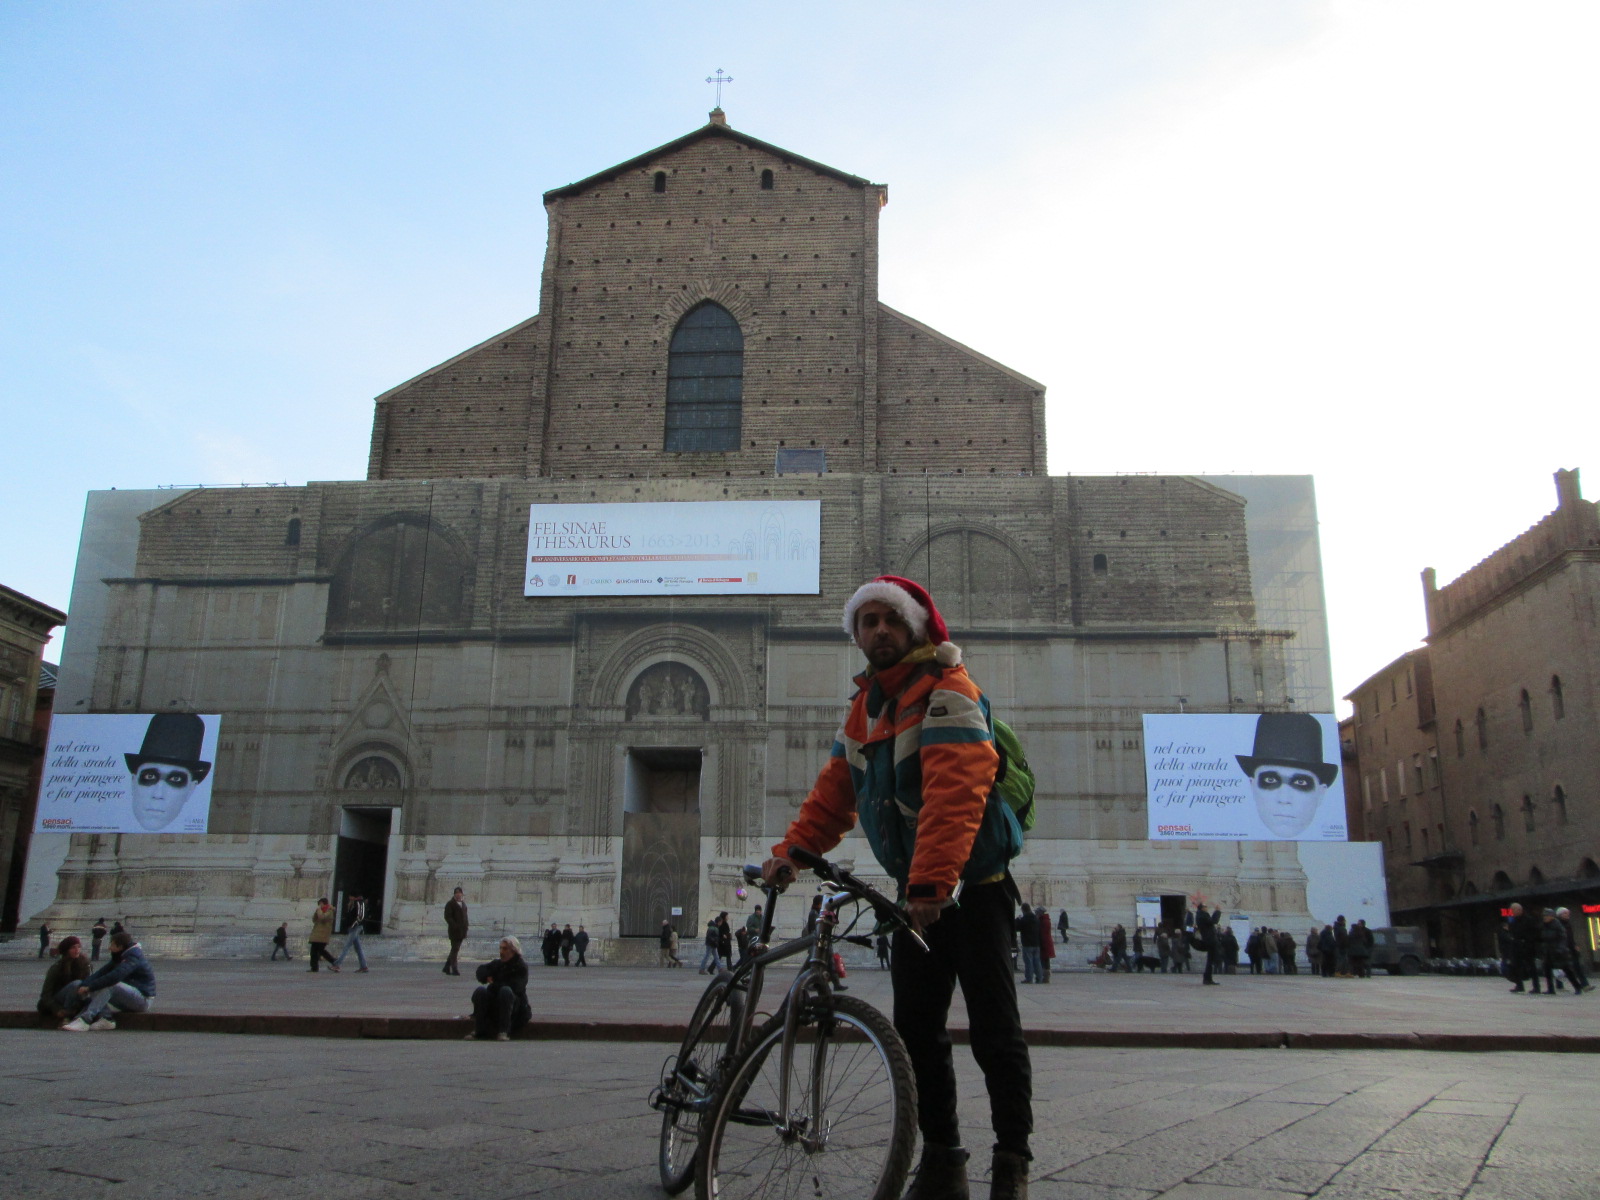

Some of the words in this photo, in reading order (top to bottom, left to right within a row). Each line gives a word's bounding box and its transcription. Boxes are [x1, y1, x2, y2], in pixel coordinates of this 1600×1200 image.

[534, 522, 606, 535] FELSINAE
[534, 535, 631, 549] THESAURUS
[55, 741, 73, 753] nel
[74, 742, 99, 753] circo
[1153, 742, 1173, 754] nel
[1176, 743, 1205, 754] circo
[52, 756, 78, 768] della
[83, 756, 116, 768] strada
[1154, 758, 1184, 770] della
[1189, 758, 1228, 770] strada
[46, 772, 75, 787] puoi
[74, 772, 125, 787] piangere
[1153, 775, 1184, 791] puoi
[1185, 775, 1242, 791] piangere
[46, 791, 54, 799] e
[53, 787, 75, 803] far
[74, 788, 125, 803] piangere
[1156, 795, 1164, 803] e
[1163, 791, 1187, 808] far
[1189, 791, 1246, 808] piangere
